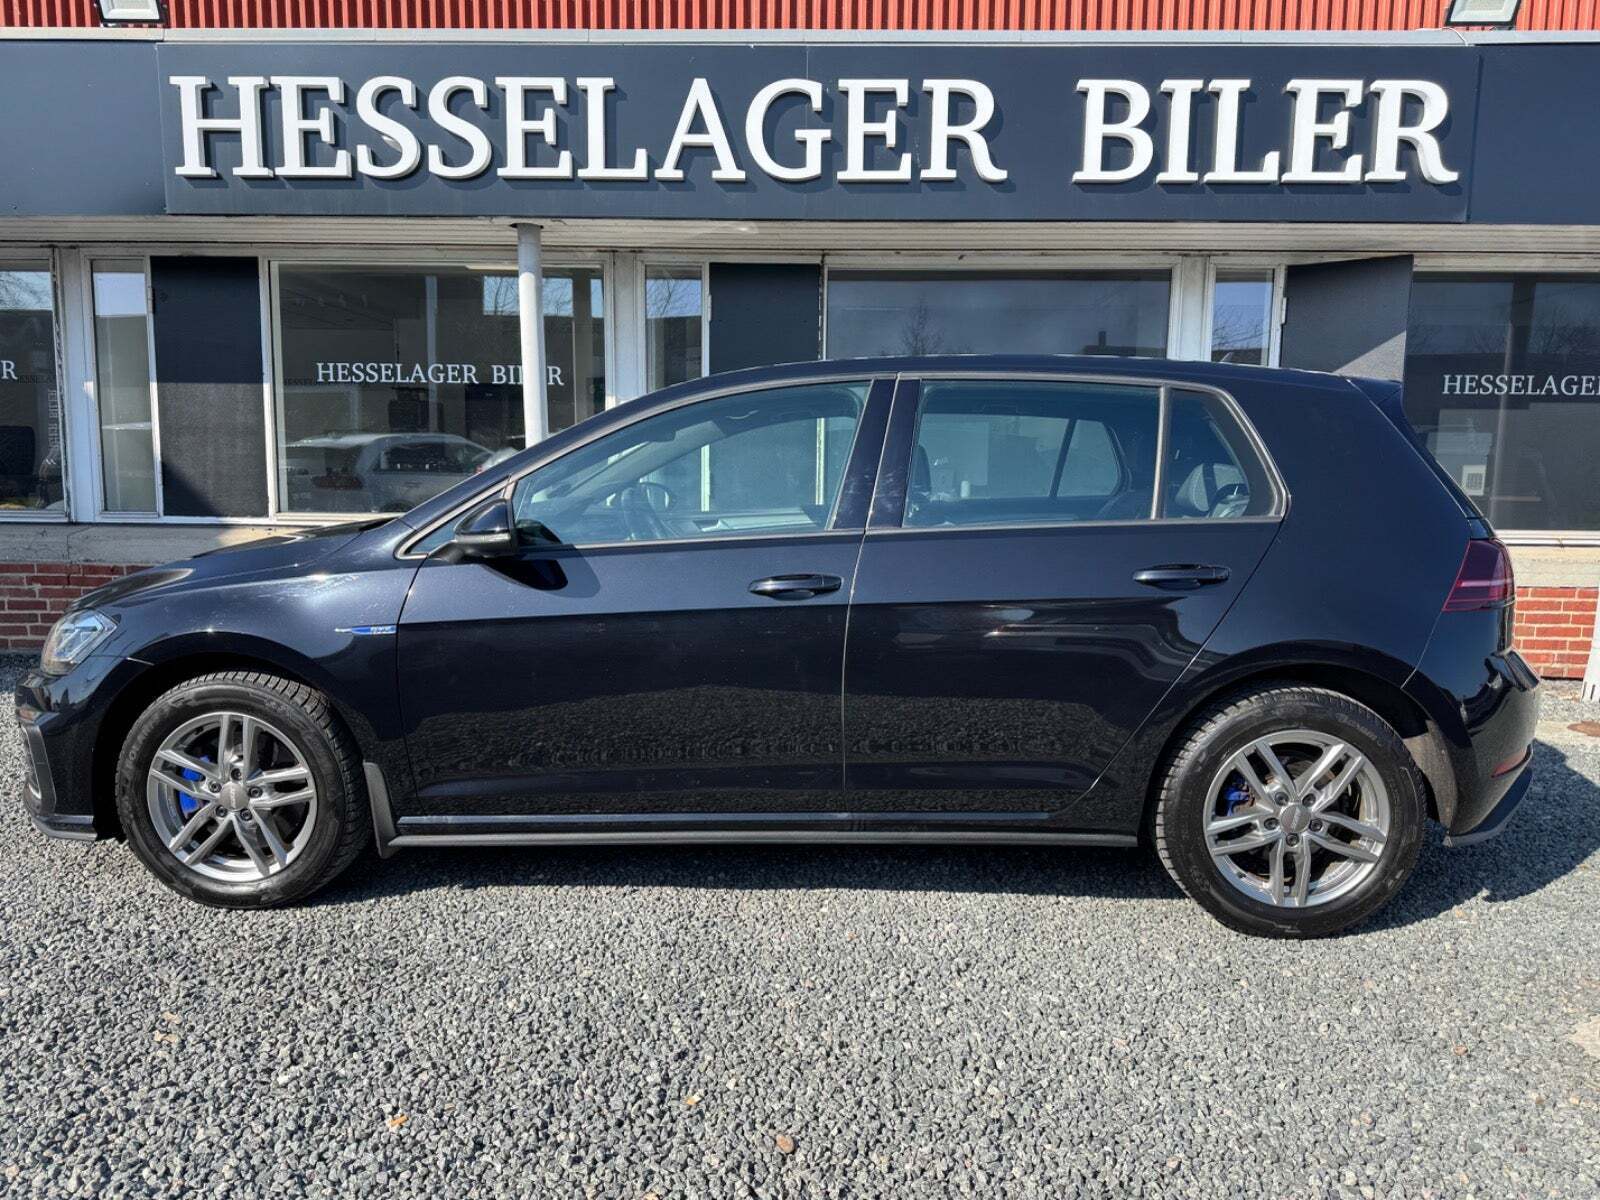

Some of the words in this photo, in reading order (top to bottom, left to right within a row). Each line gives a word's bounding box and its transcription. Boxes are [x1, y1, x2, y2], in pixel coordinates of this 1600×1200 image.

[168, 75, 1008, 184] HESSELAGER
[1072, 79, 1459, 185] BILER
[316, 362, 479, 384] HESSELAGER
[490, 364, 565, 386] BIR
[1442, 374, 1600, 396] HESSELAGE
